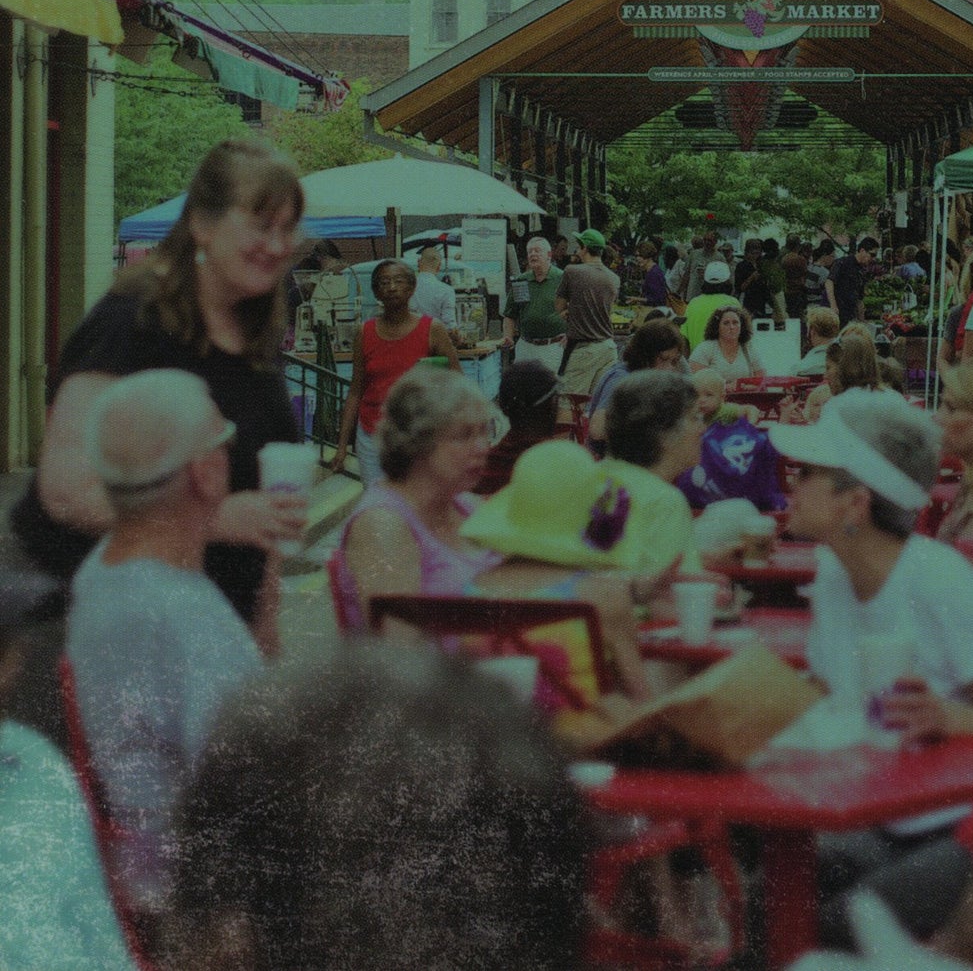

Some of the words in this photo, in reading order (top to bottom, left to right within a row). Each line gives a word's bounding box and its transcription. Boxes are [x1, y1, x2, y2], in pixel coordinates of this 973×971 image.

[621, 4, 726, 19] FARMERS
[787, 4, 880, 19] MARKET
[813, 71, 849, 79] ACCEPTED
